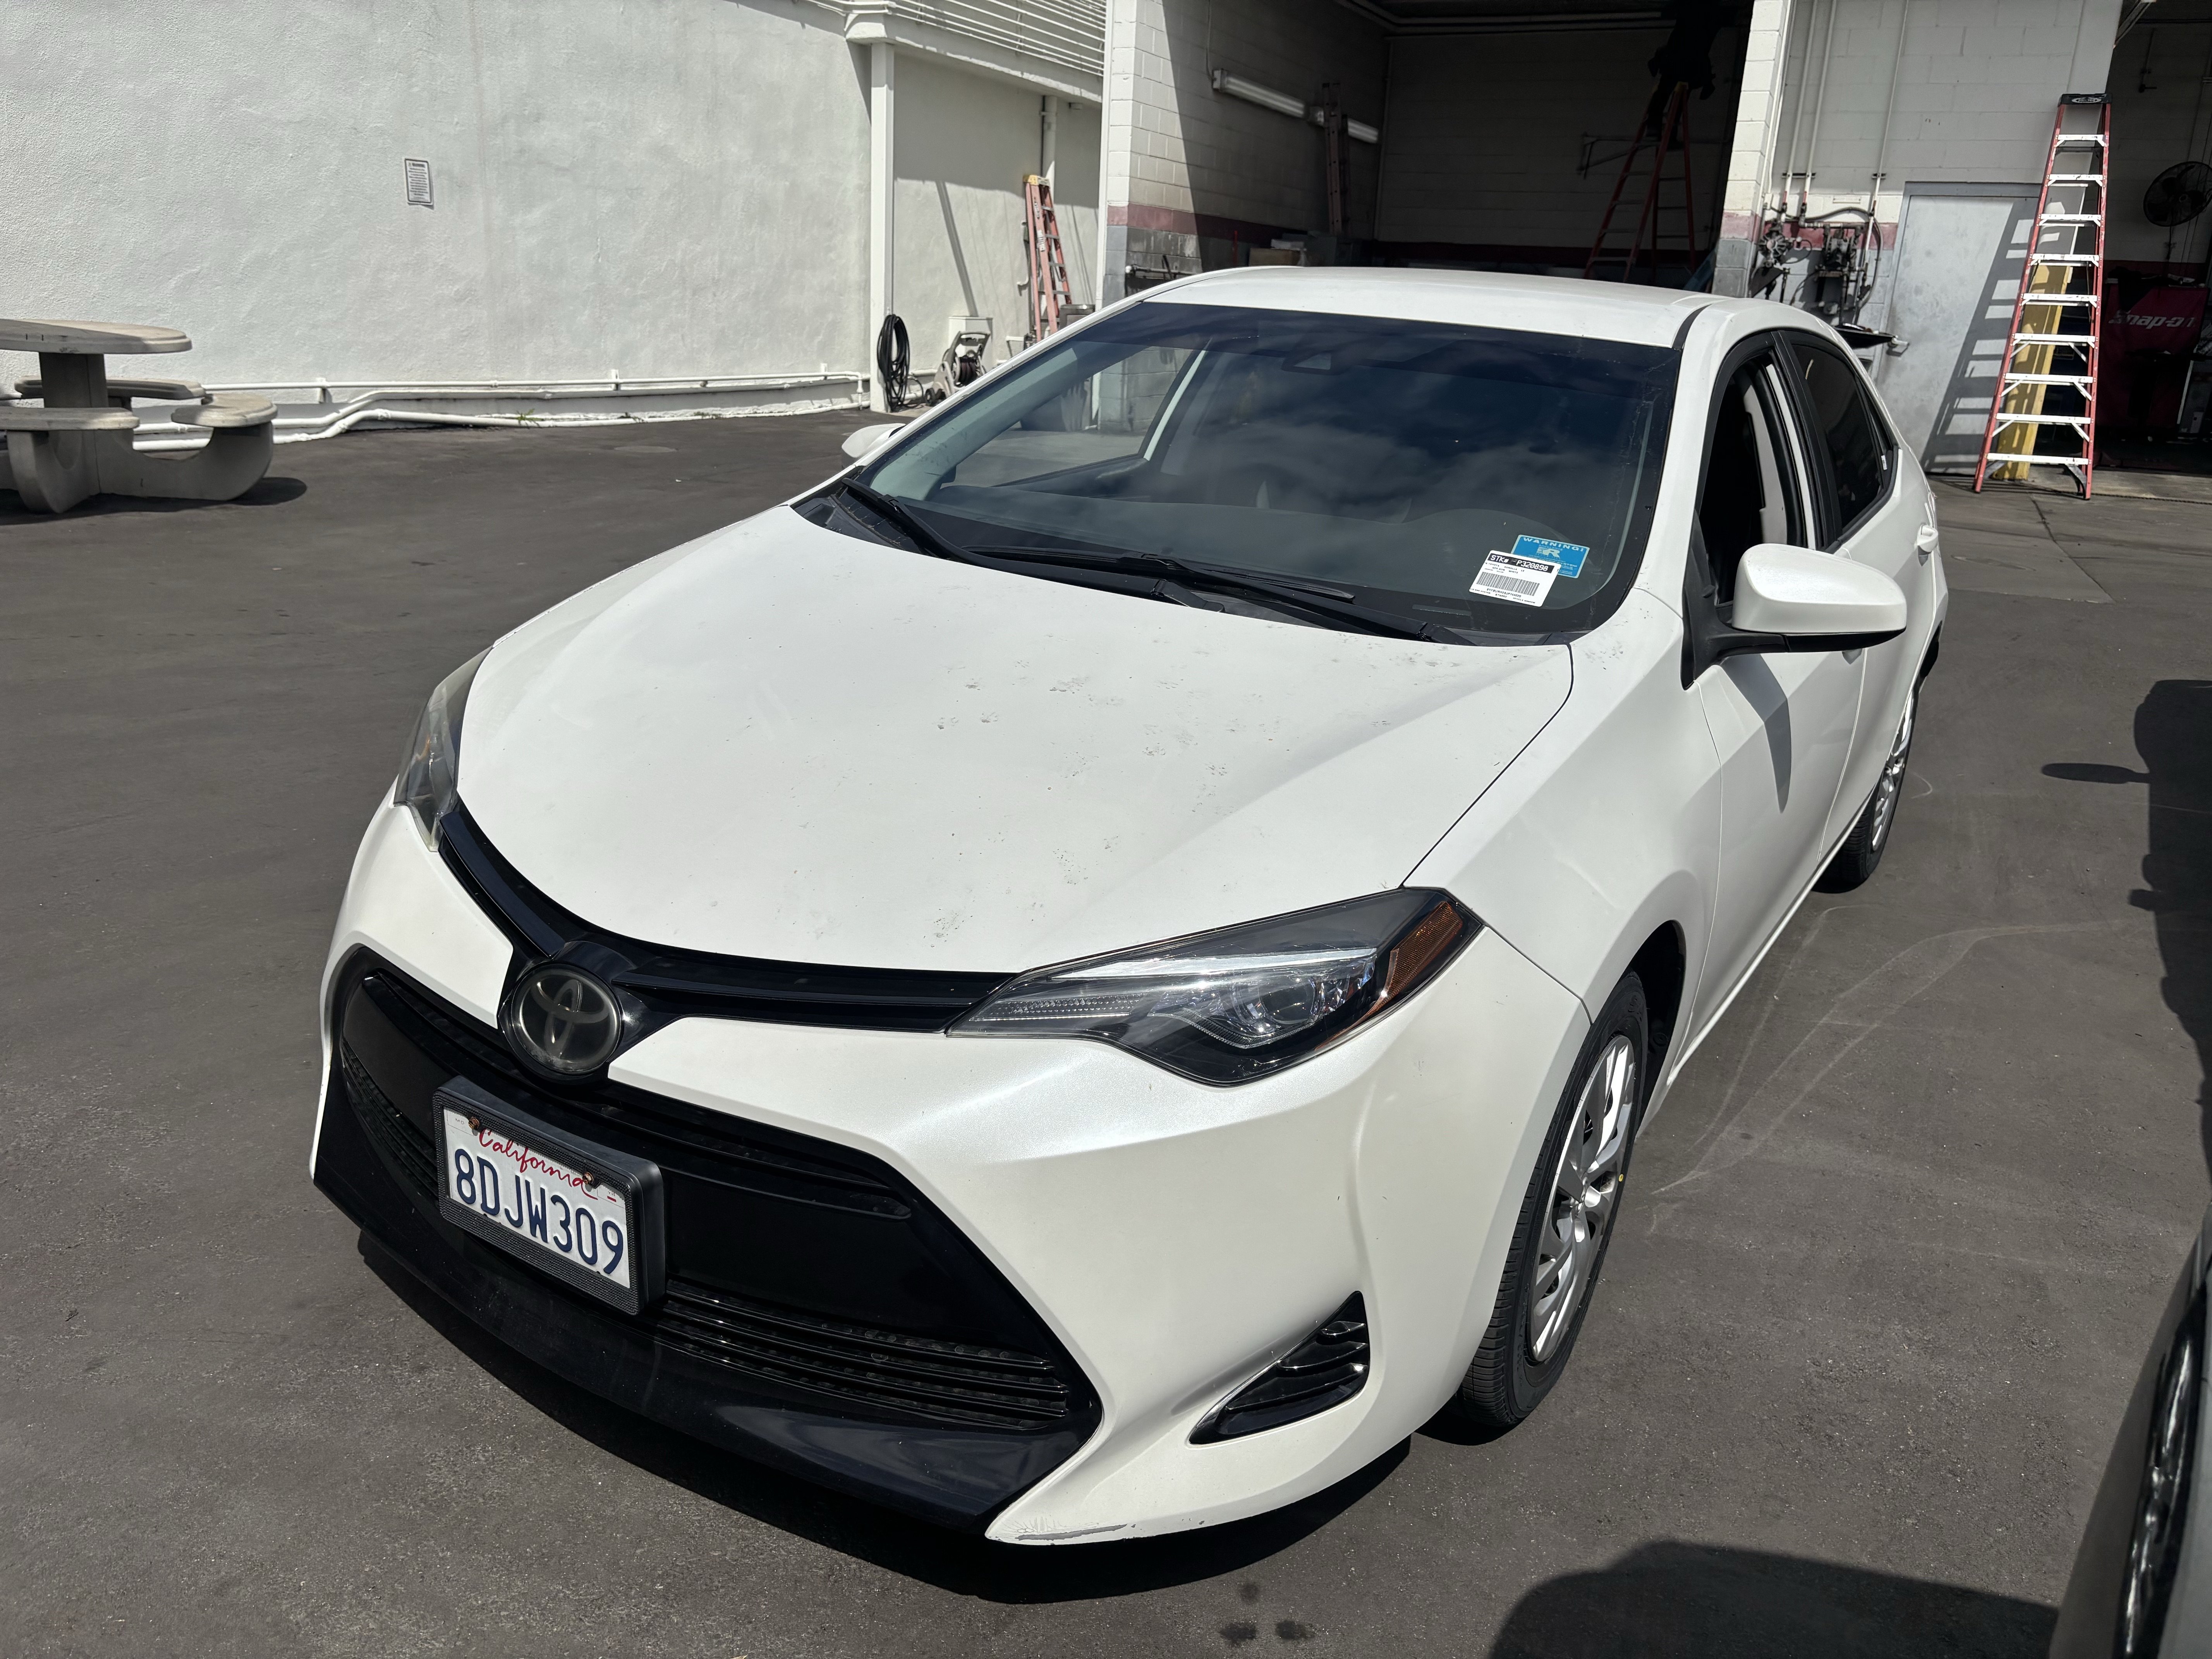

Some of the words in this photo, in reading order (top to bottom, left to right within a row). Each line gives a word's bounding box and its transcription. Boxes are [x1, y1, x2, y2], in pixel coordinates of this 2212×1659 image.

[1490, 555, 1509, 563] STK#
[1516, 560, 1549, 571] P320898
[1523, 537, 1584, 551] WARNING!
[479, 1128, 598, 1200] California
[454, 1149, 624, 1274] 8DJW309
